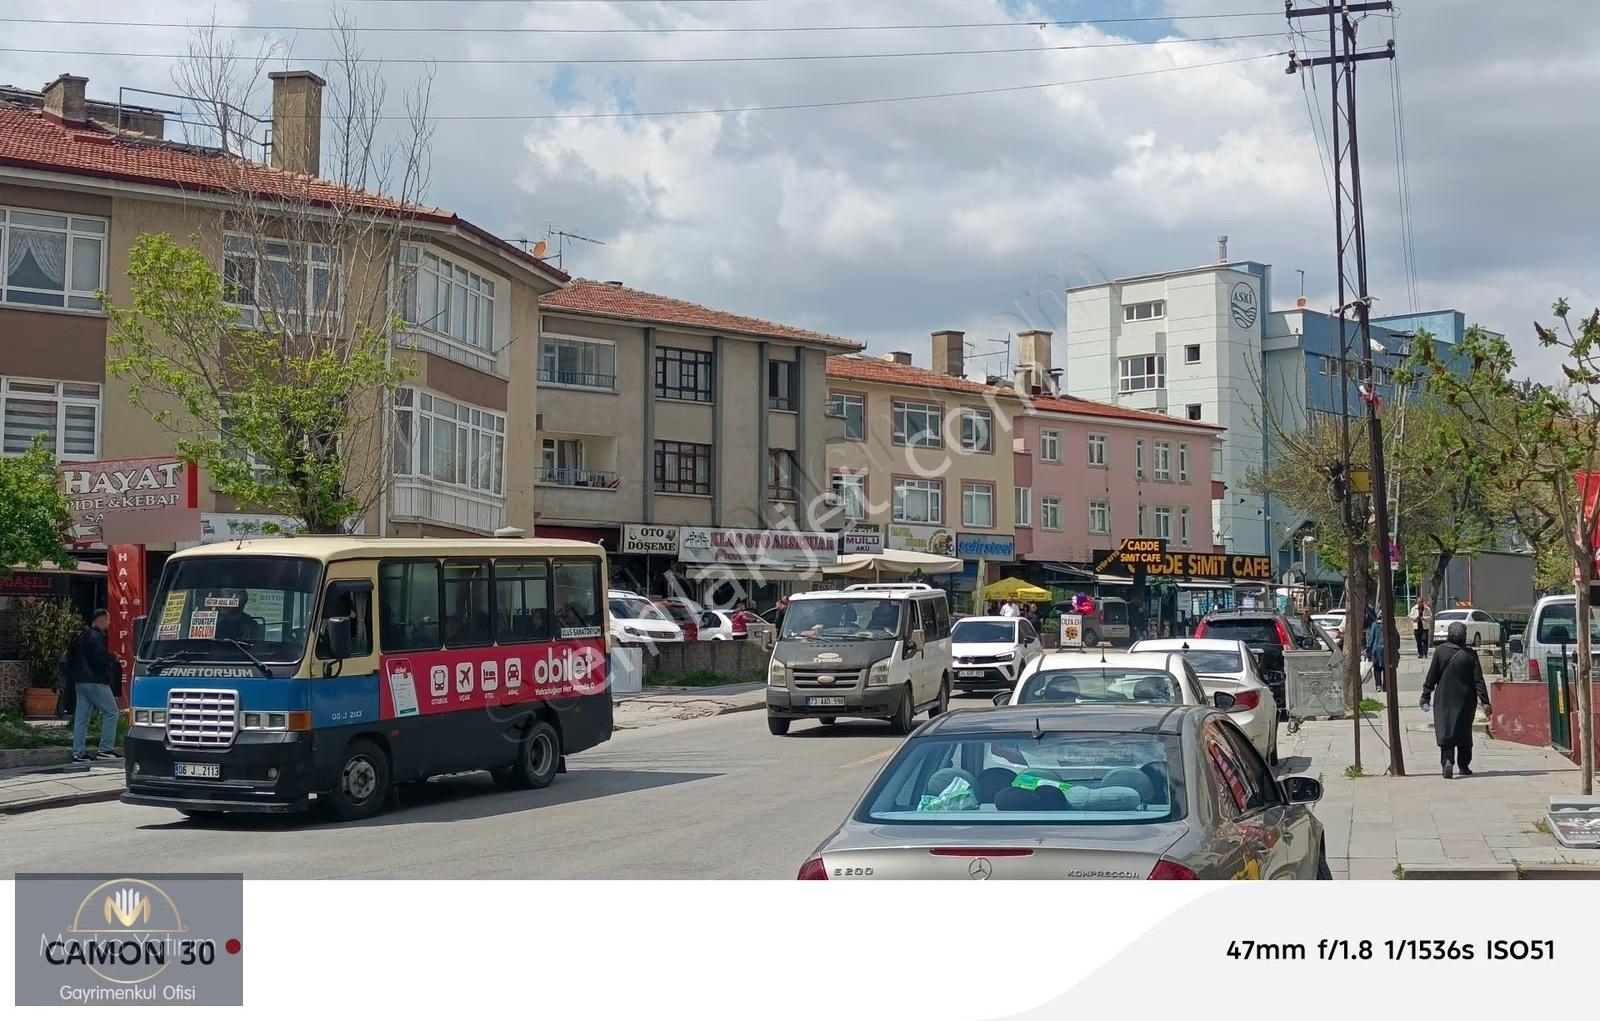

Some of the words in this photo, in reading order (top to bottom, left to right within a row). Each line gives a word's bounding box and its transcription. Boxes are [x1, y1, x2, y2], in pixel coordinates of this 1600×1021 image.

[63, 461, 184, 495] HAYAT
[641, 527, 664, 537] OTO
[628, 539, 676, 552] DÖŞEME
[845, 535, 880, 545] MUTLU
[1127, 540, 1160, 551] CADDE
[1141, 553, 1161, 562] CAFE
[1232, 557, 1270, 577] CAFE
[118, 553, 128, 619] HAYAT
[535, 646, 593, 684] obilet
[160, 667, 254, 677] SANATORYUM
[178, 765, 188, 775] 06
[190, 765, 196, 775] J
[202, 766, 219, 776] 2113
[833, 868, 842, 876] E
[844, 867, 874, 876] 200
[1067, 870, 1140, 878] KOMPRESSOR
